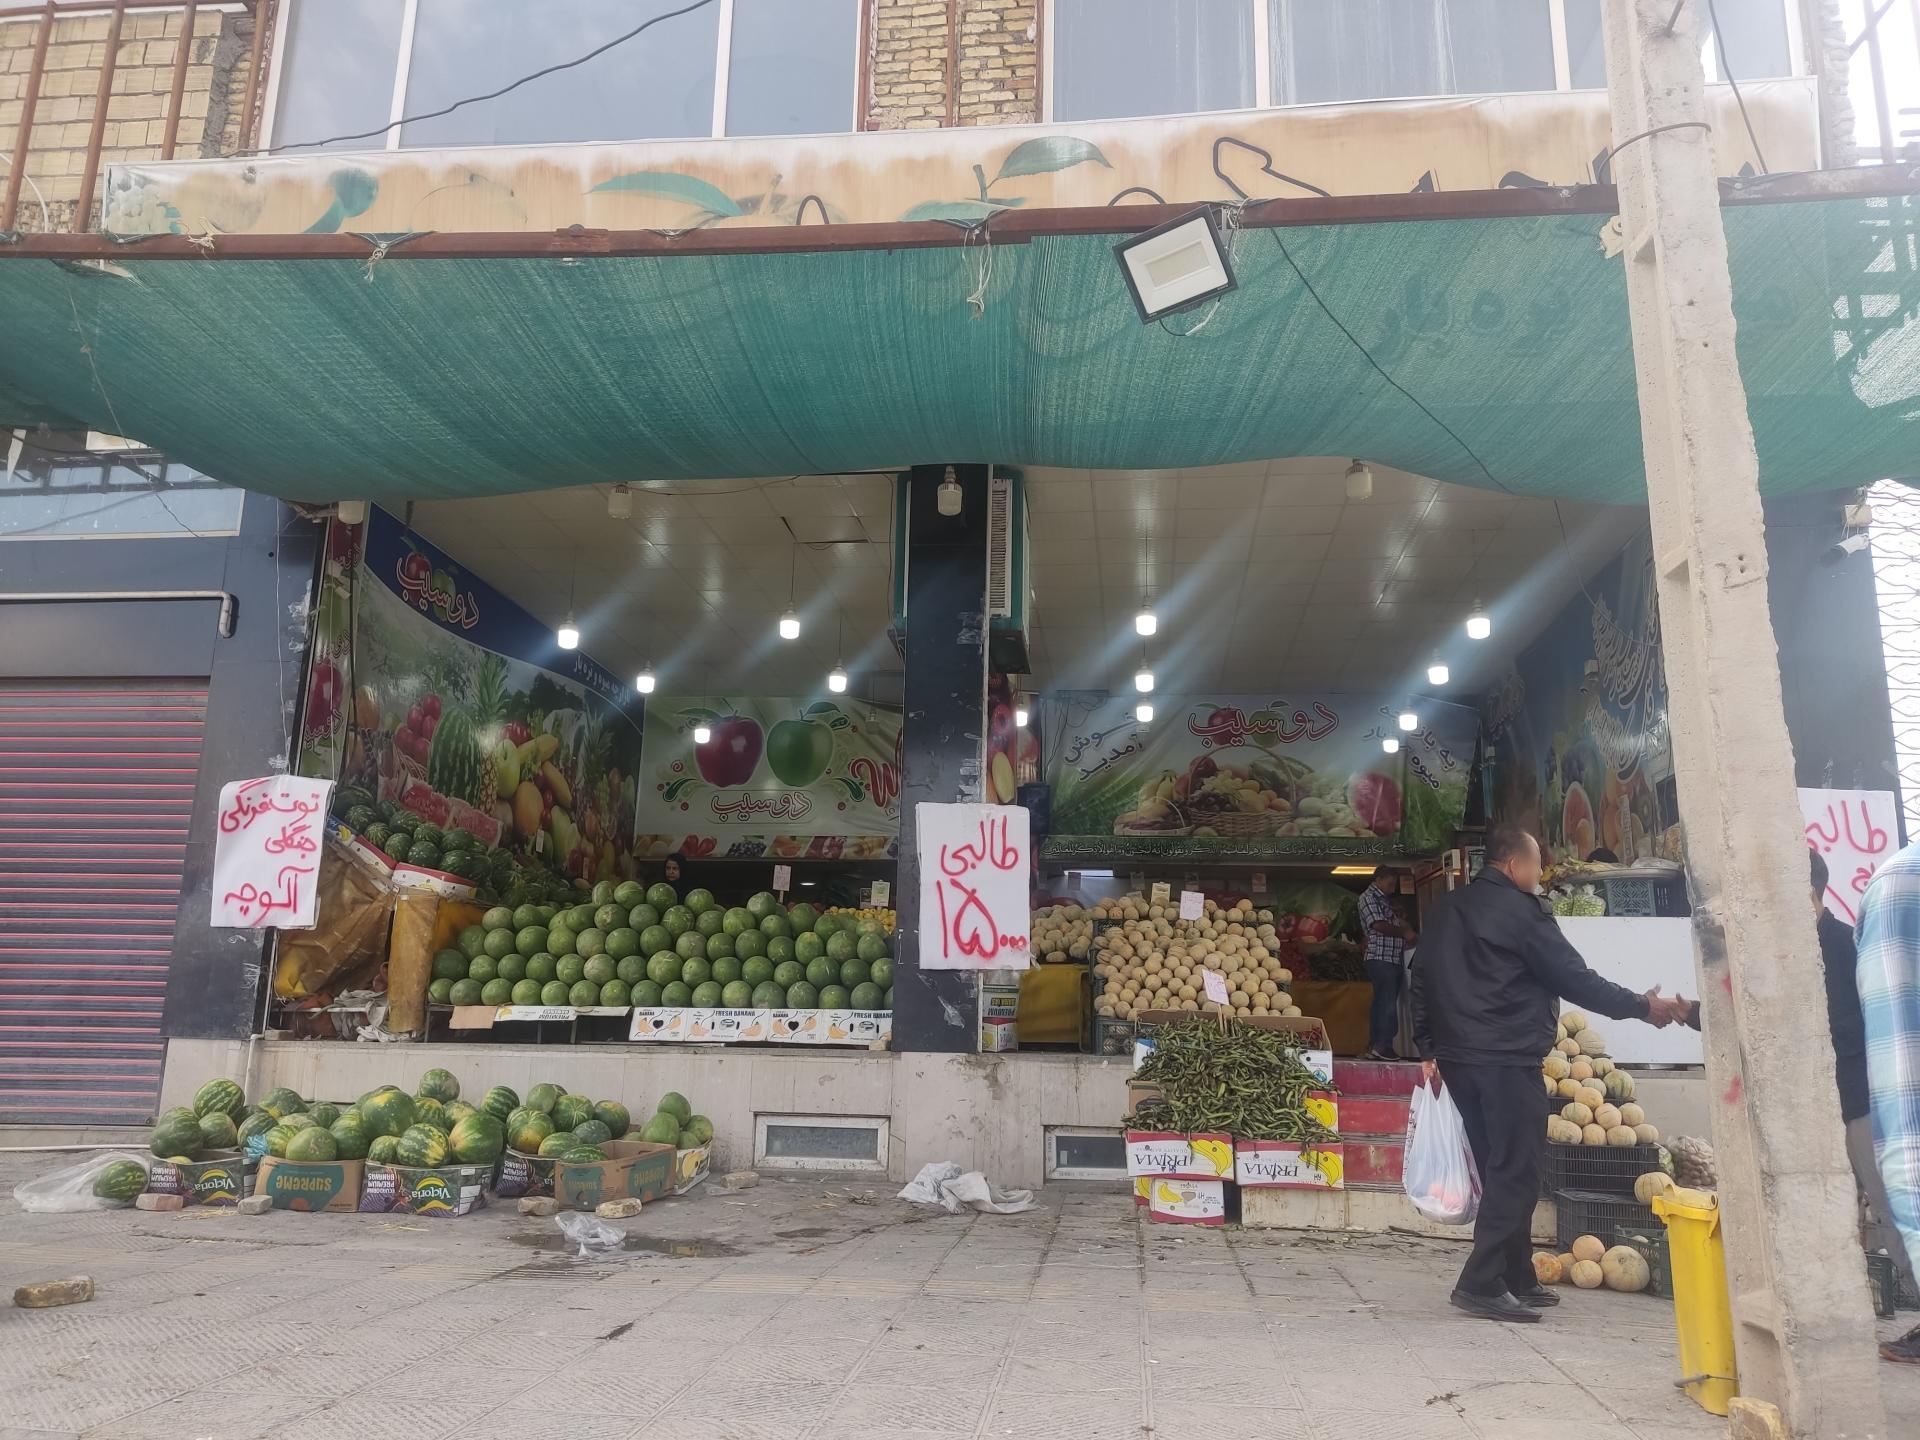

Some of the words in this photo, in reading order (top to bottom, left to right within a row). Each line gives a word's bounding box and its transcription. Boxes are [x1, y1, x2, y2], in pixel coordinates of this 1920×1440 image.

[264, 824, 318, 859] جنگلی
[940, 814, 1019, 877] طالبی
[223, 865, 315, 927] آلوچه
[1135, 1152, 1188, 1167] PRIMA
[1243, 1162, 1300, 1177] PRIMA
[194, 1178, 236, 1192] Victoria
[411, 1186, 451, 1200] Victoria
